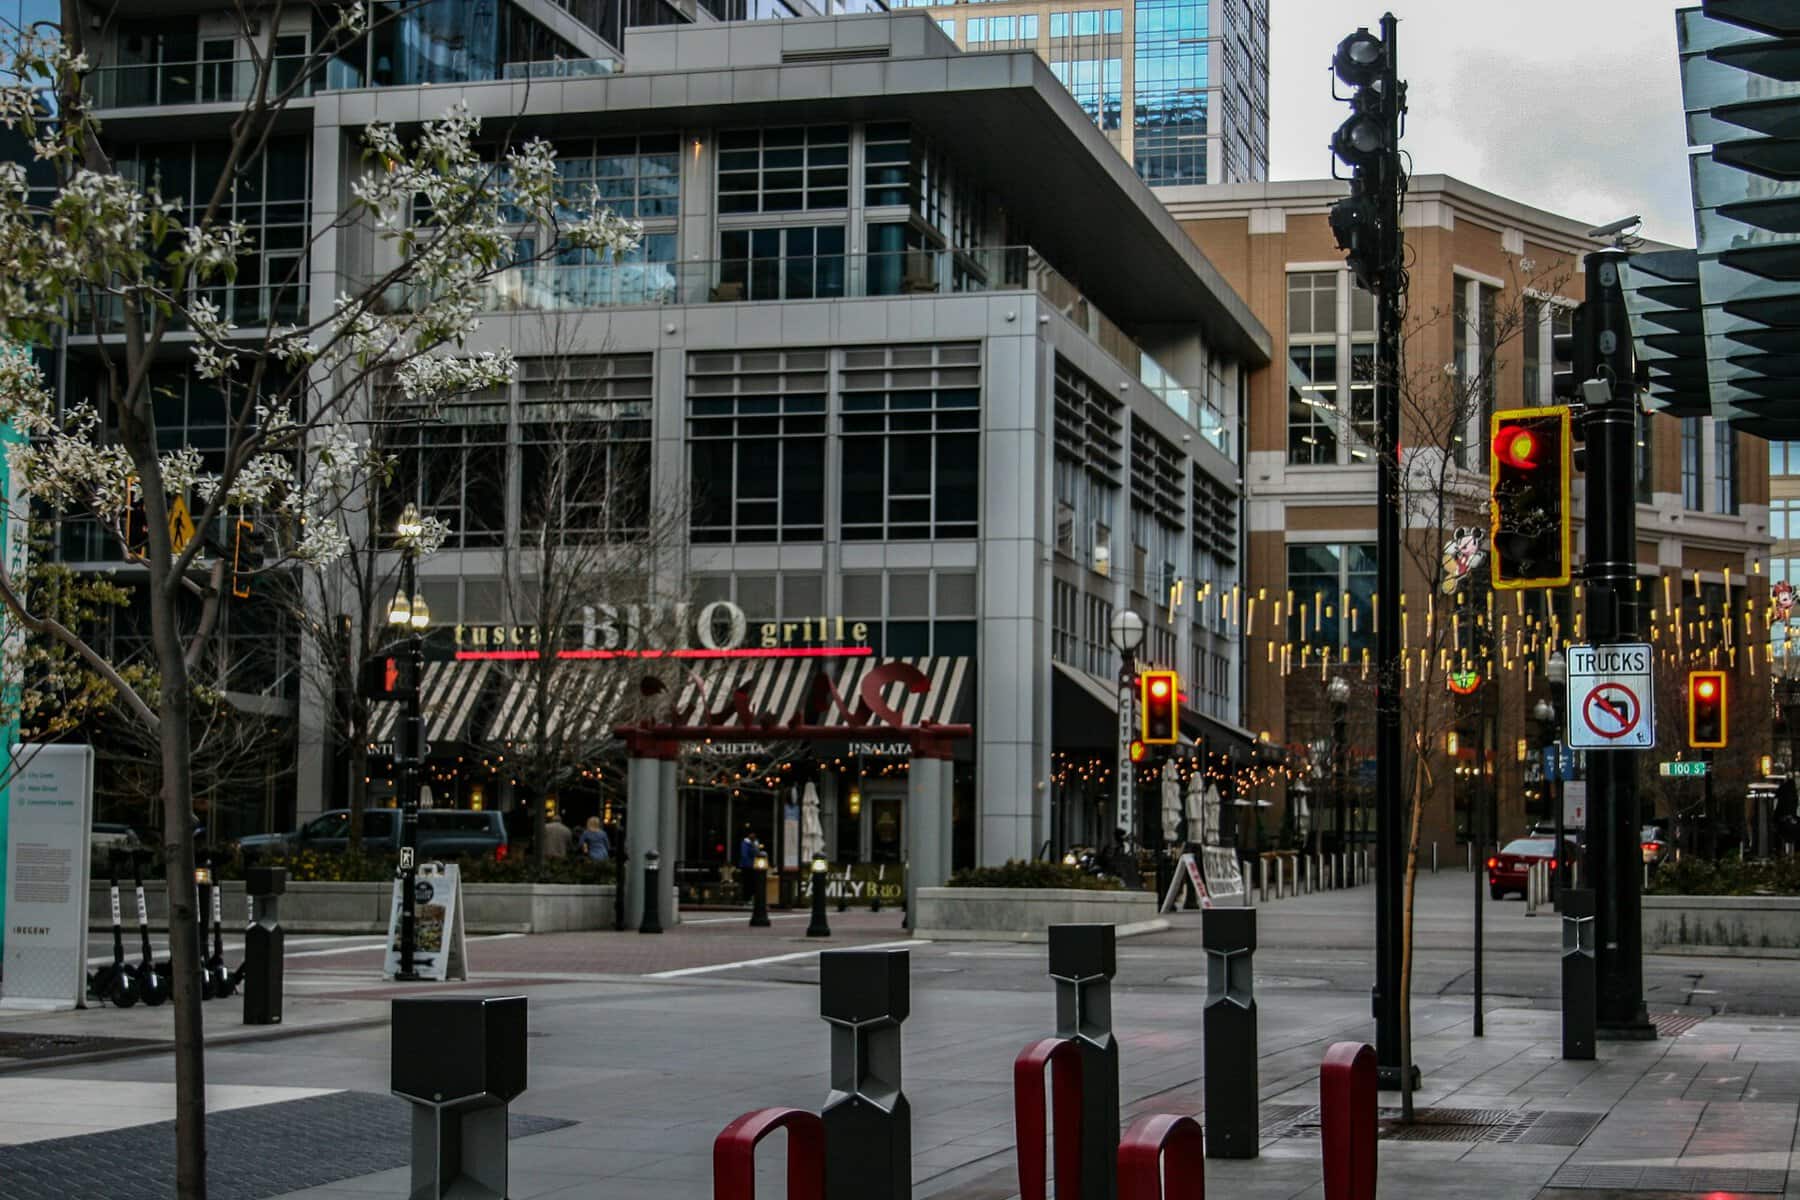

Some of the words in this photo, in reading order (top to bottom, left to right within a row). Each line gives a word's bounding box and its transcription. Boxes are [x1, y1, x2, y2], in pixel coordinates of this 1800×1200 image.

[455, 624, 562, 645] tusca
[761, 616, 867, 648] grille
[1576, 653, 1643, 672] TRUCKS
[1120, 699, 1129, 749] CITY
[1674, 763, 1690, 775] 100
[1120, 759, 1129, 823] CREEK
